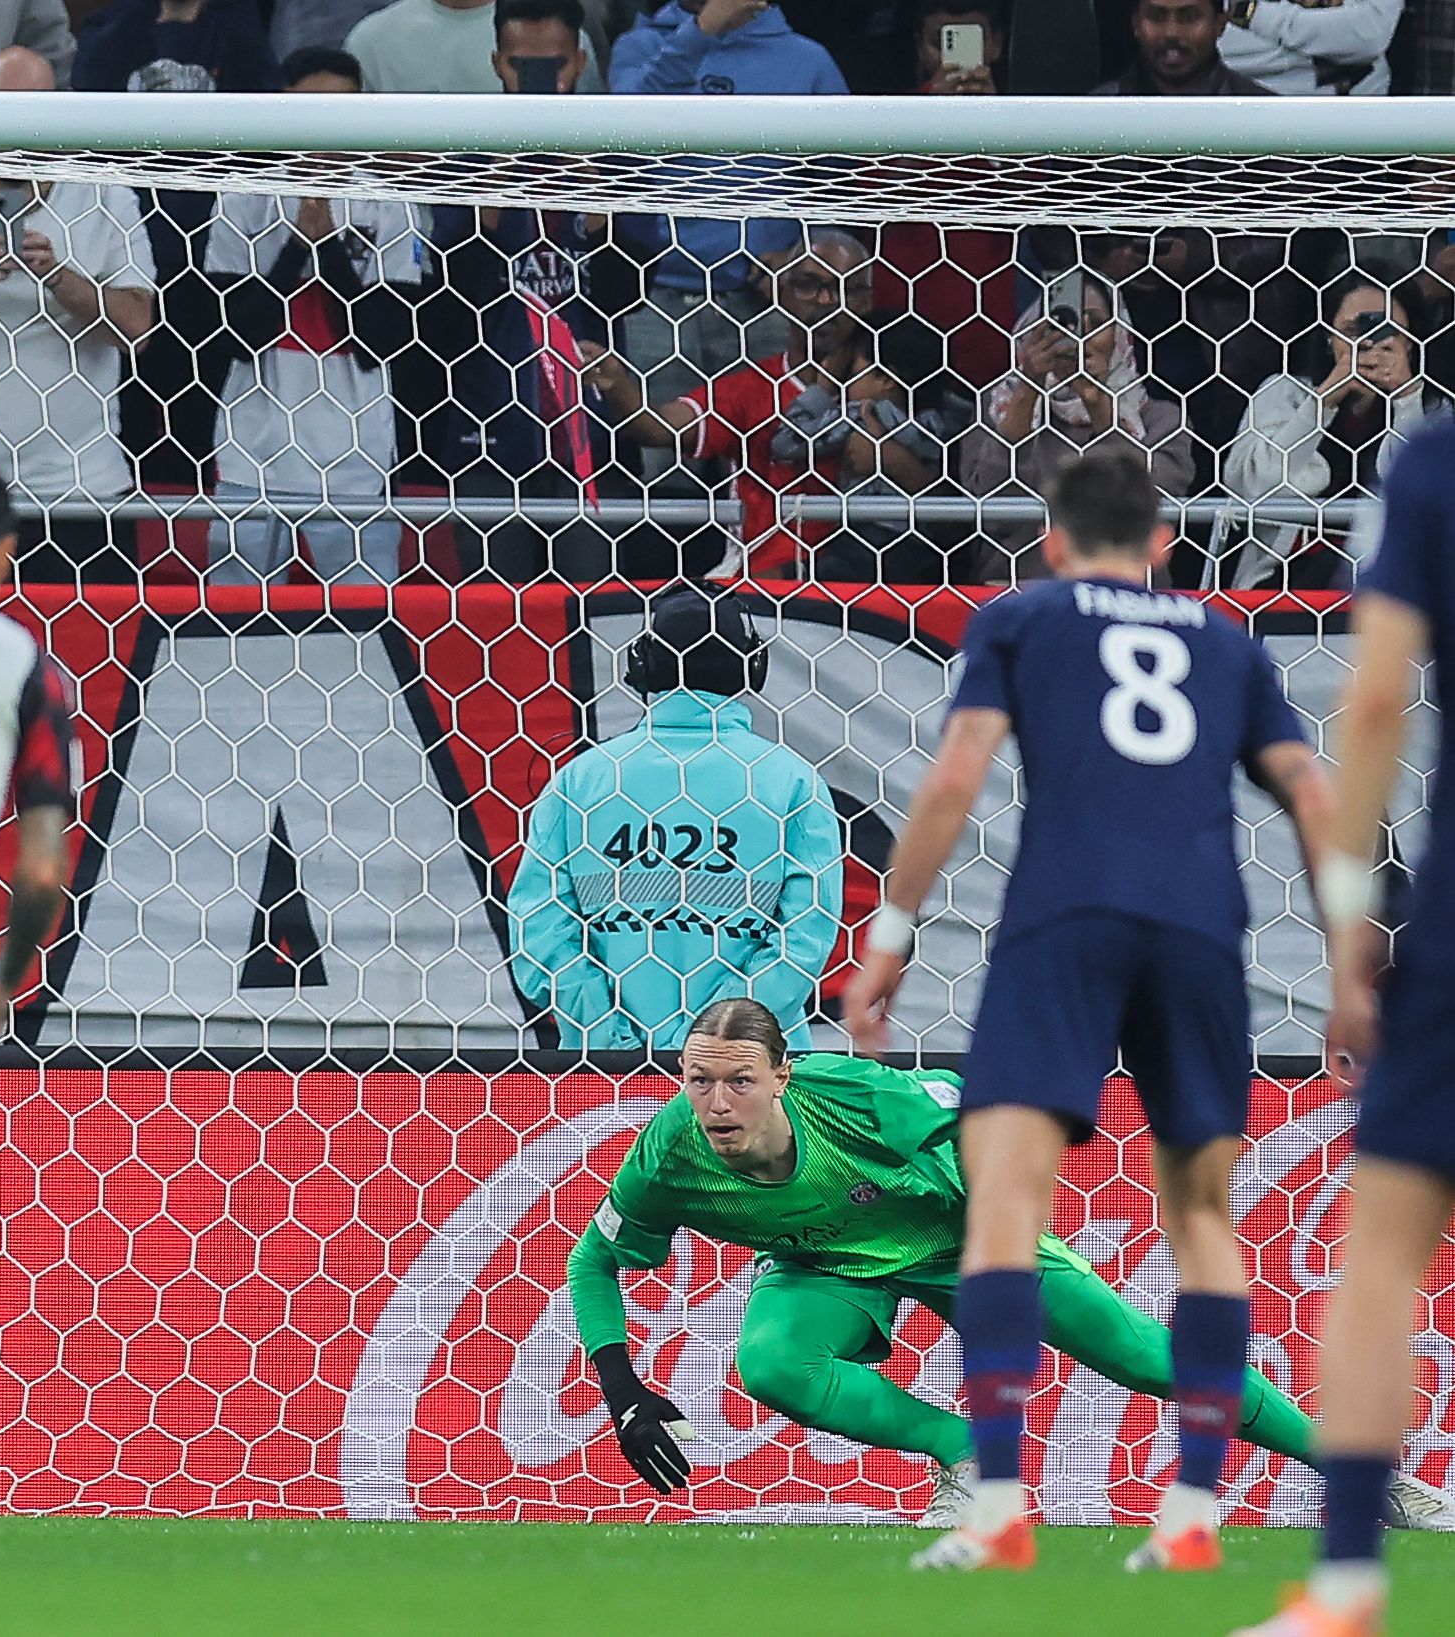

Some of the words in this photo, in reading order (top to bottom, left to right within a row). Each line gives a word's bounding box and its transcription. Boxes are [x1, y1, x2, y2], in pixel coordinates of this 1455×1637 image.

[502, 247, 591, 279] ATAR
[1098, 621, 1199, 767] 8
[603, 822, 738, 874] 4023
